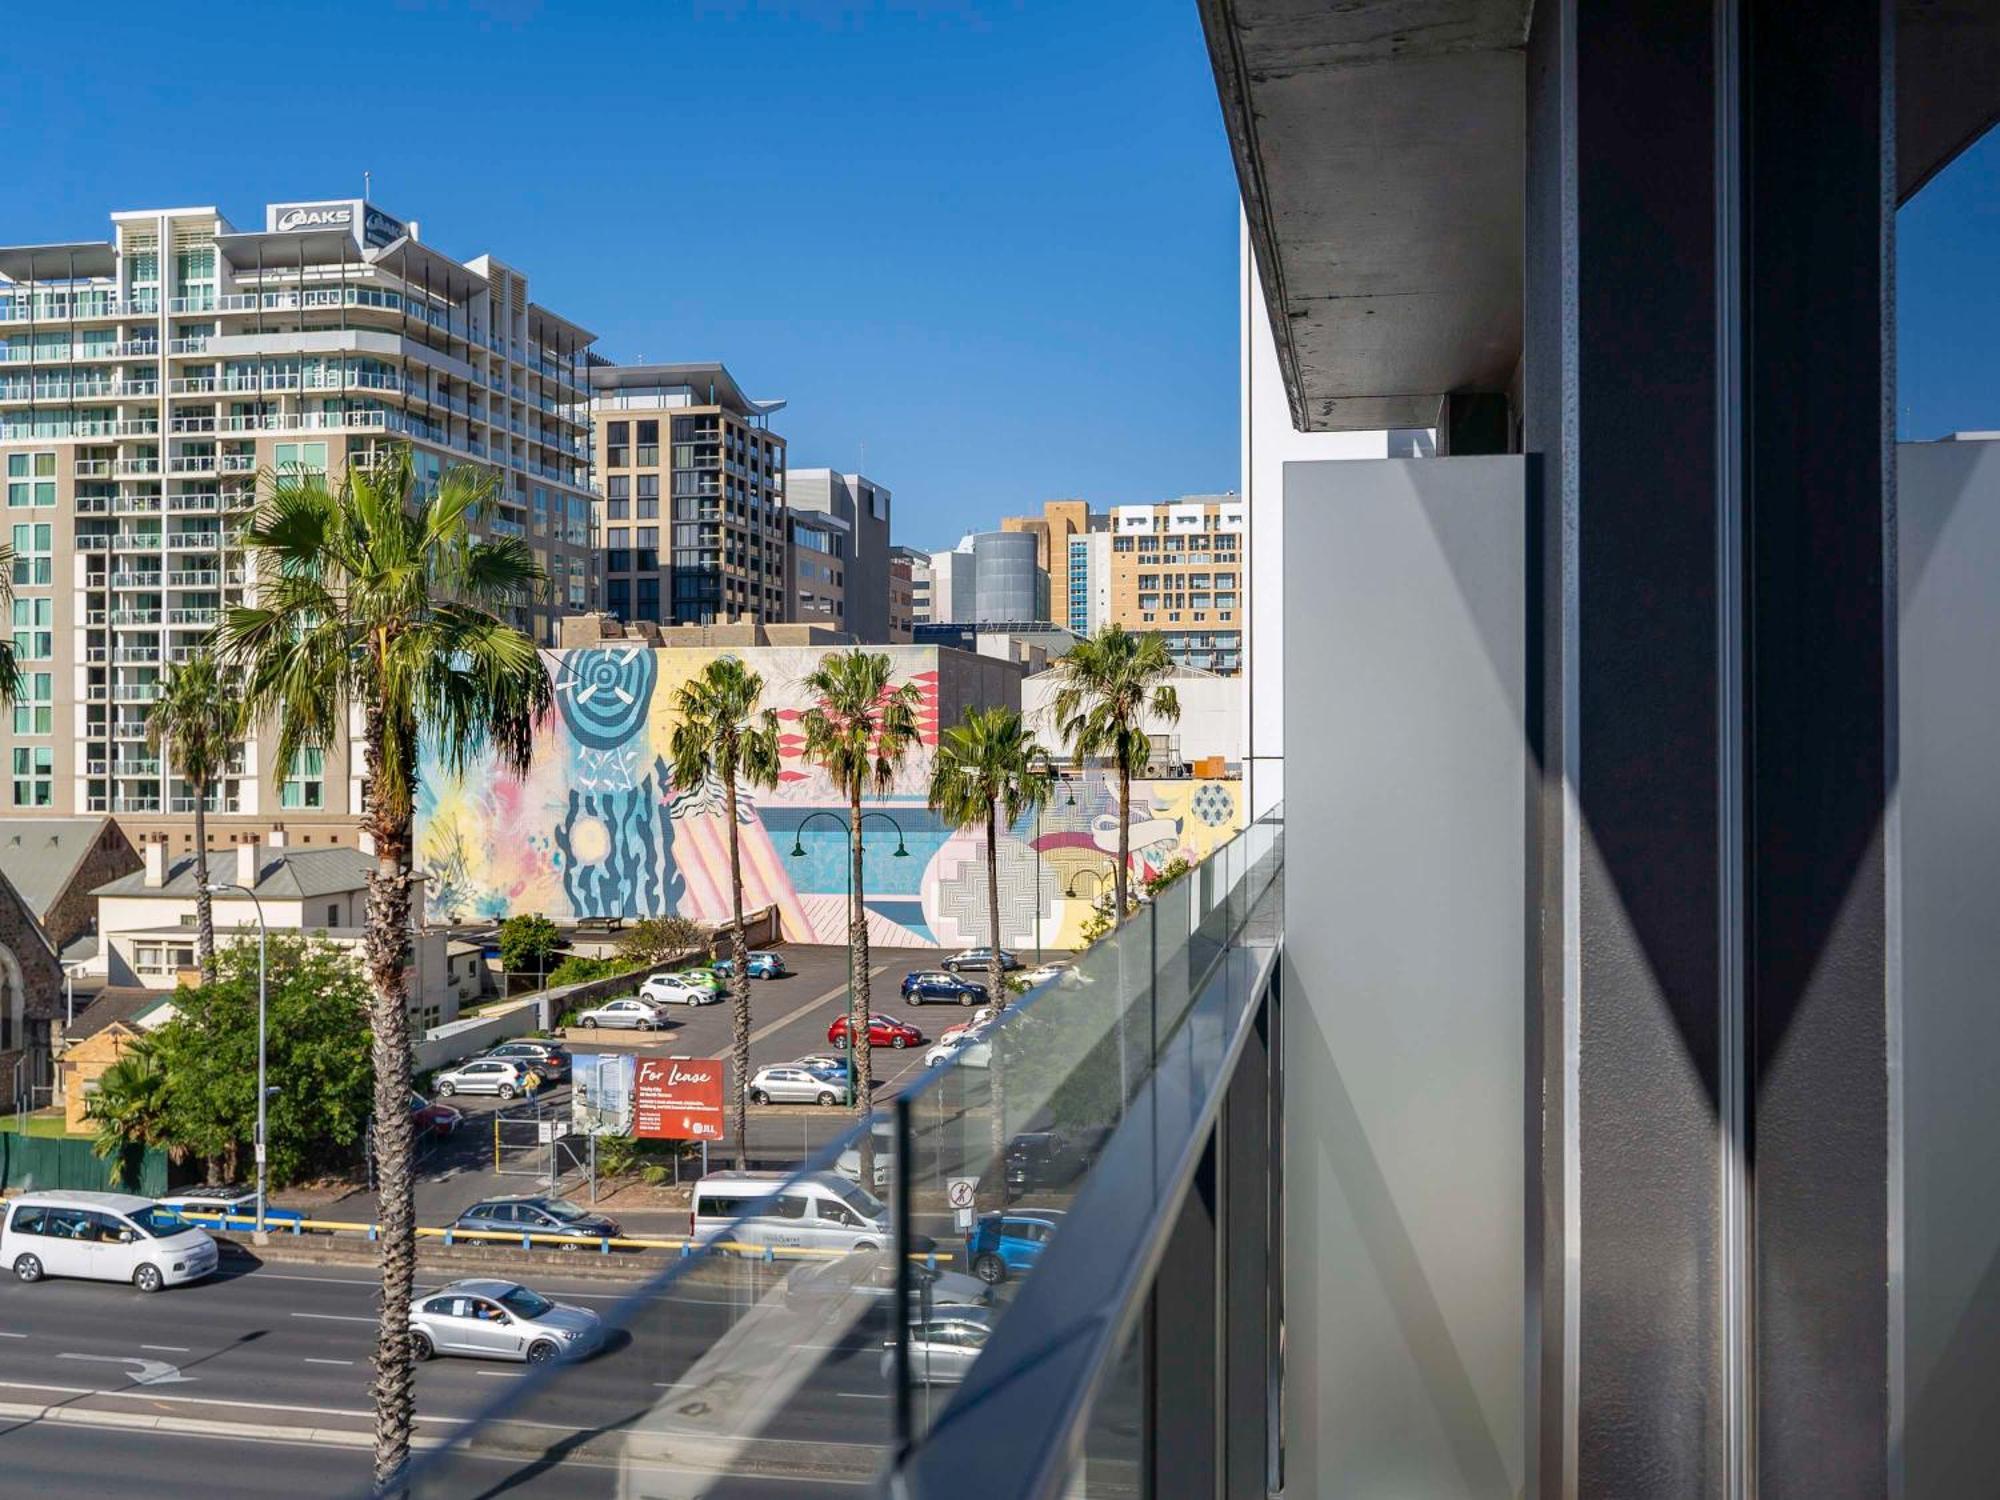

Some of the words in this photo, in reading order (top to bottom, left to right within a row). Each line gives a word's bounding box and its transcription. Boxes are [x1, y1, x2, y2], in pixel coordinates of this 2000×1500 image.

[280, 209, 350, 229] OAKS
[640, 1062, 664, 1083] For
[668, 1063, 712, 1086] Lease
